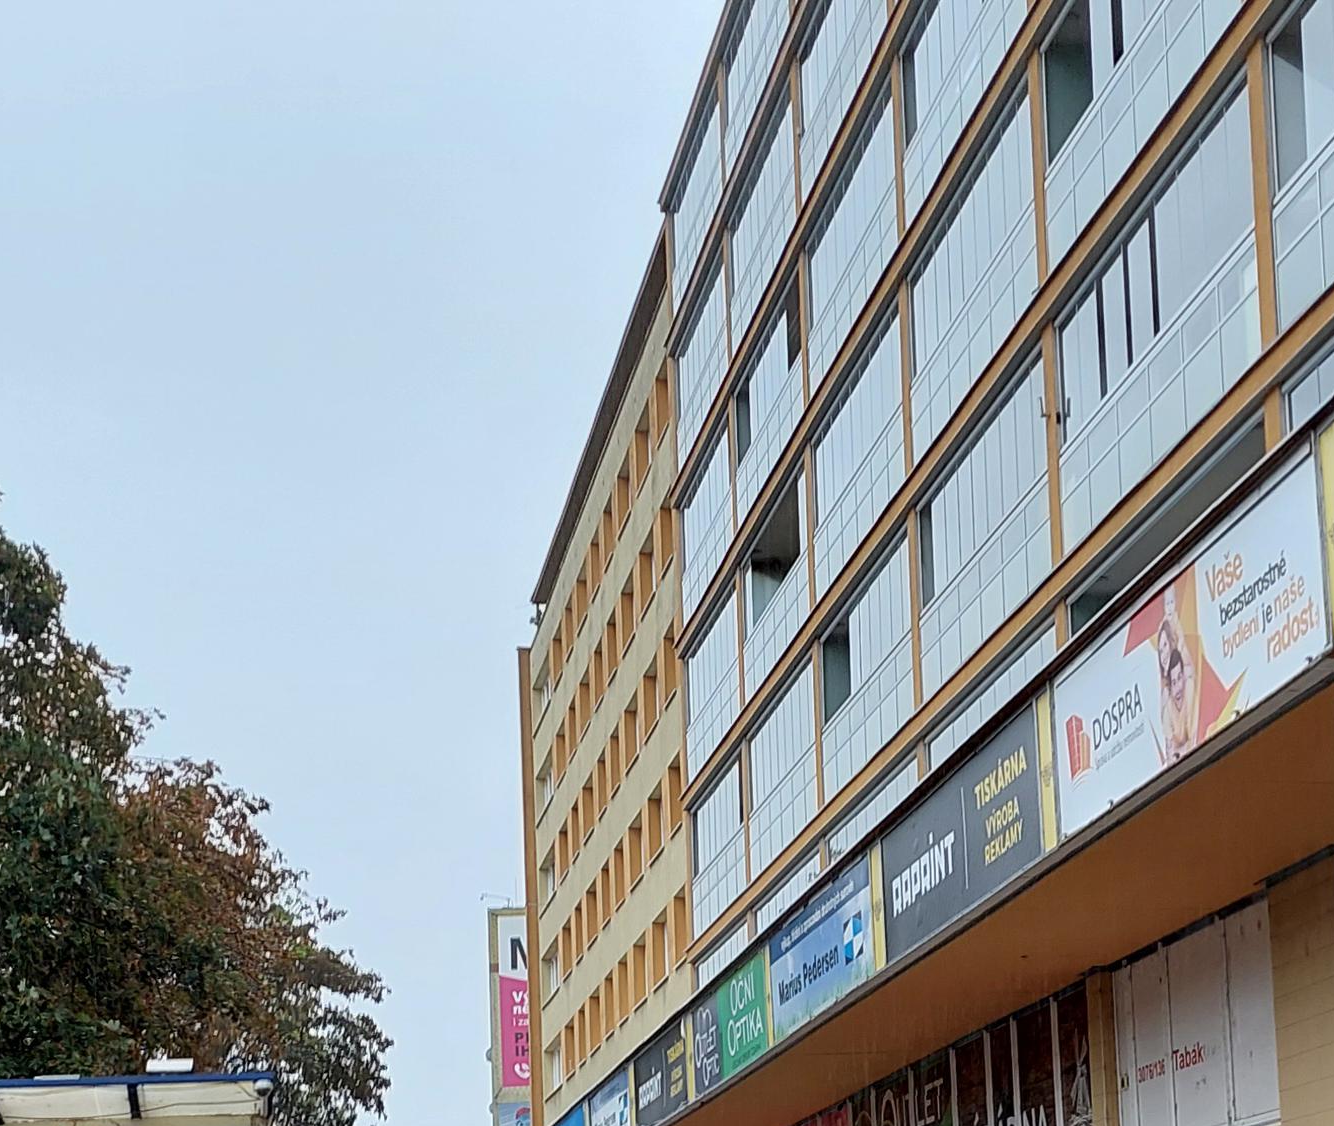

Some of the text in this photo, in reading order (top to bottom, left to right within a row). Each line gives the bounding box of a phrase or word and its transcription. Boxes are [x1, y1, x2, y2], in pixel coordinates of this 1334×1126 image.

[1205, 552, 1244, 602] Vaše
[1219, 549, 1287, 627] bezstarostné
[1222, 575, 1305, 659] bydlení je naše
[1092, 683, 1142, 750] DOSPRA
[974, 746, 1027, 810] TISKÁRNA
[984, 818, 1023, 866] REKLAMY
[985, 796, 1020, 838] VÝROBA
[891, 830, 955, 918] RAPRINT
[730, 962, 755, 1017] OČNÍ
[778, 944, 839, 1006] Marius Pedersen
[727, 1006, 764, 1057] OPTIKA
[1171, 1042, 1205, 1071] Tabák
